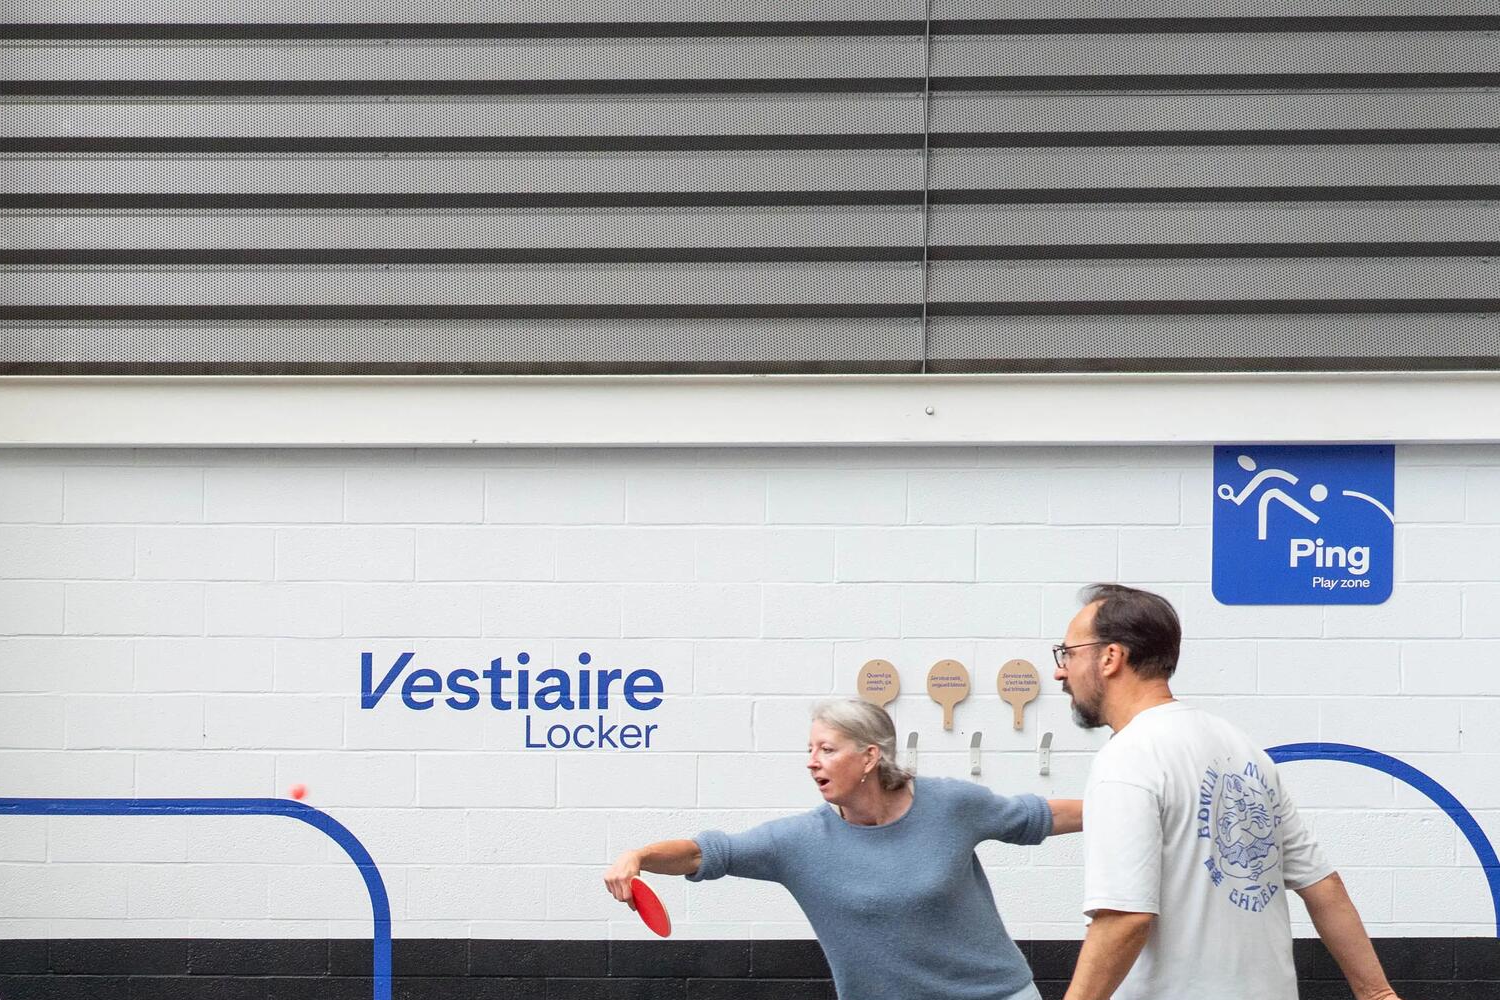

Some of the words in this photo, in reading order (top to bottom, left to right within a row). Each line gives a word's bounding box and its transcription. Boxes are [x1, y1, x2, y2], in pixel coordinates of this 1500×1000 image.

[1290, 538, 1370, 575] Ping
[1312, 576, 1339, 590] Play
[1340, 579, 1370, 588] zone
[361, 652, 664, 711] Vestiaire
[525, 715, 658, 749] Locker
[1198, 766, 1218, 838] EDWIN
